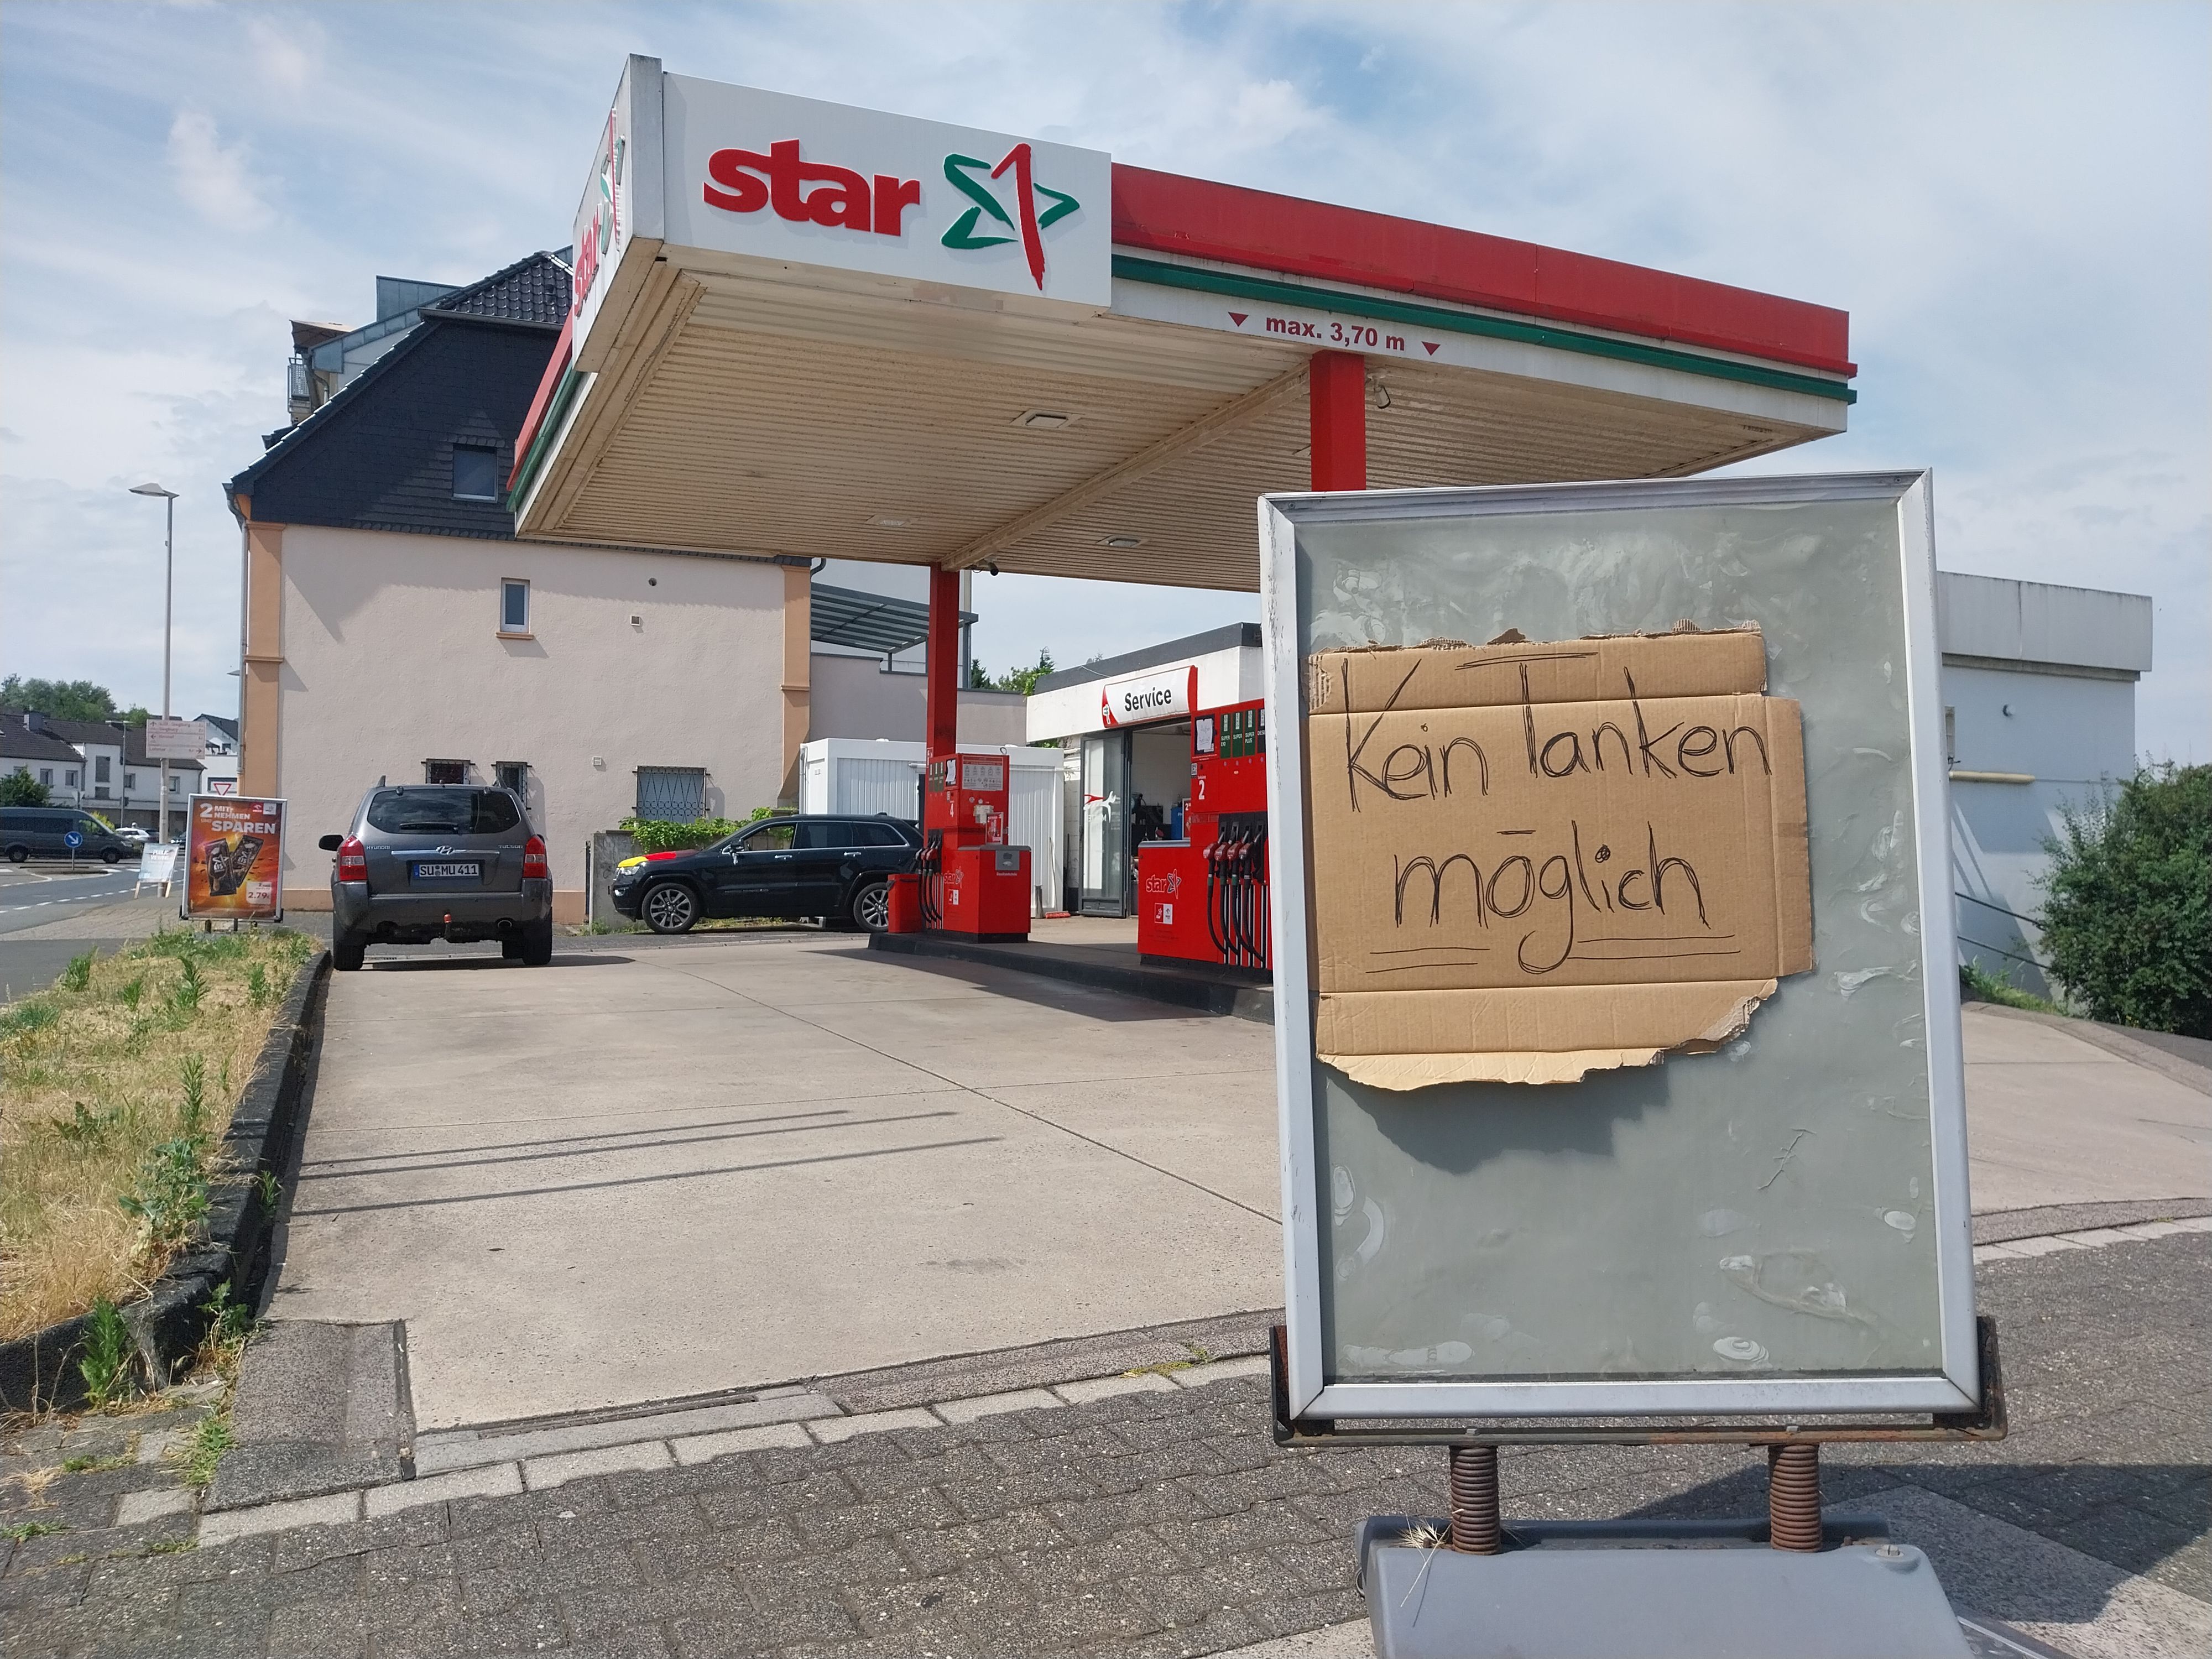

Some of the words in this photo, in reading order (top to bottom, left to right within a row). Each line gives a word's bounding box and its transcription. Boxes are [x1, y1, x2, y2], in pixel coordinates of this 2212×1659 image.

[703, 138, 920, 236] star
[1266, 316, 1322, 339] max.
[1330, 322, 1378, 347] 3,70
[1386, 333, 1405, 351] m
[1124, 686, 1172, 712] Service
[1340, 658, 1488, 813] Kein
[1454, 651, 1771, 779] Tanken
[1198, 780, 1205, 800] 2
[200, 802, 213, 818] 2
[950, 803, 954, 818] 4
[211, 821, 276, 834] SPAREN
[420, 865, 434, 875] SU
[441, 865, 456, 875] MU
[458, 864, 477, 875] 411
[1145, 874, 1167, 893] star
